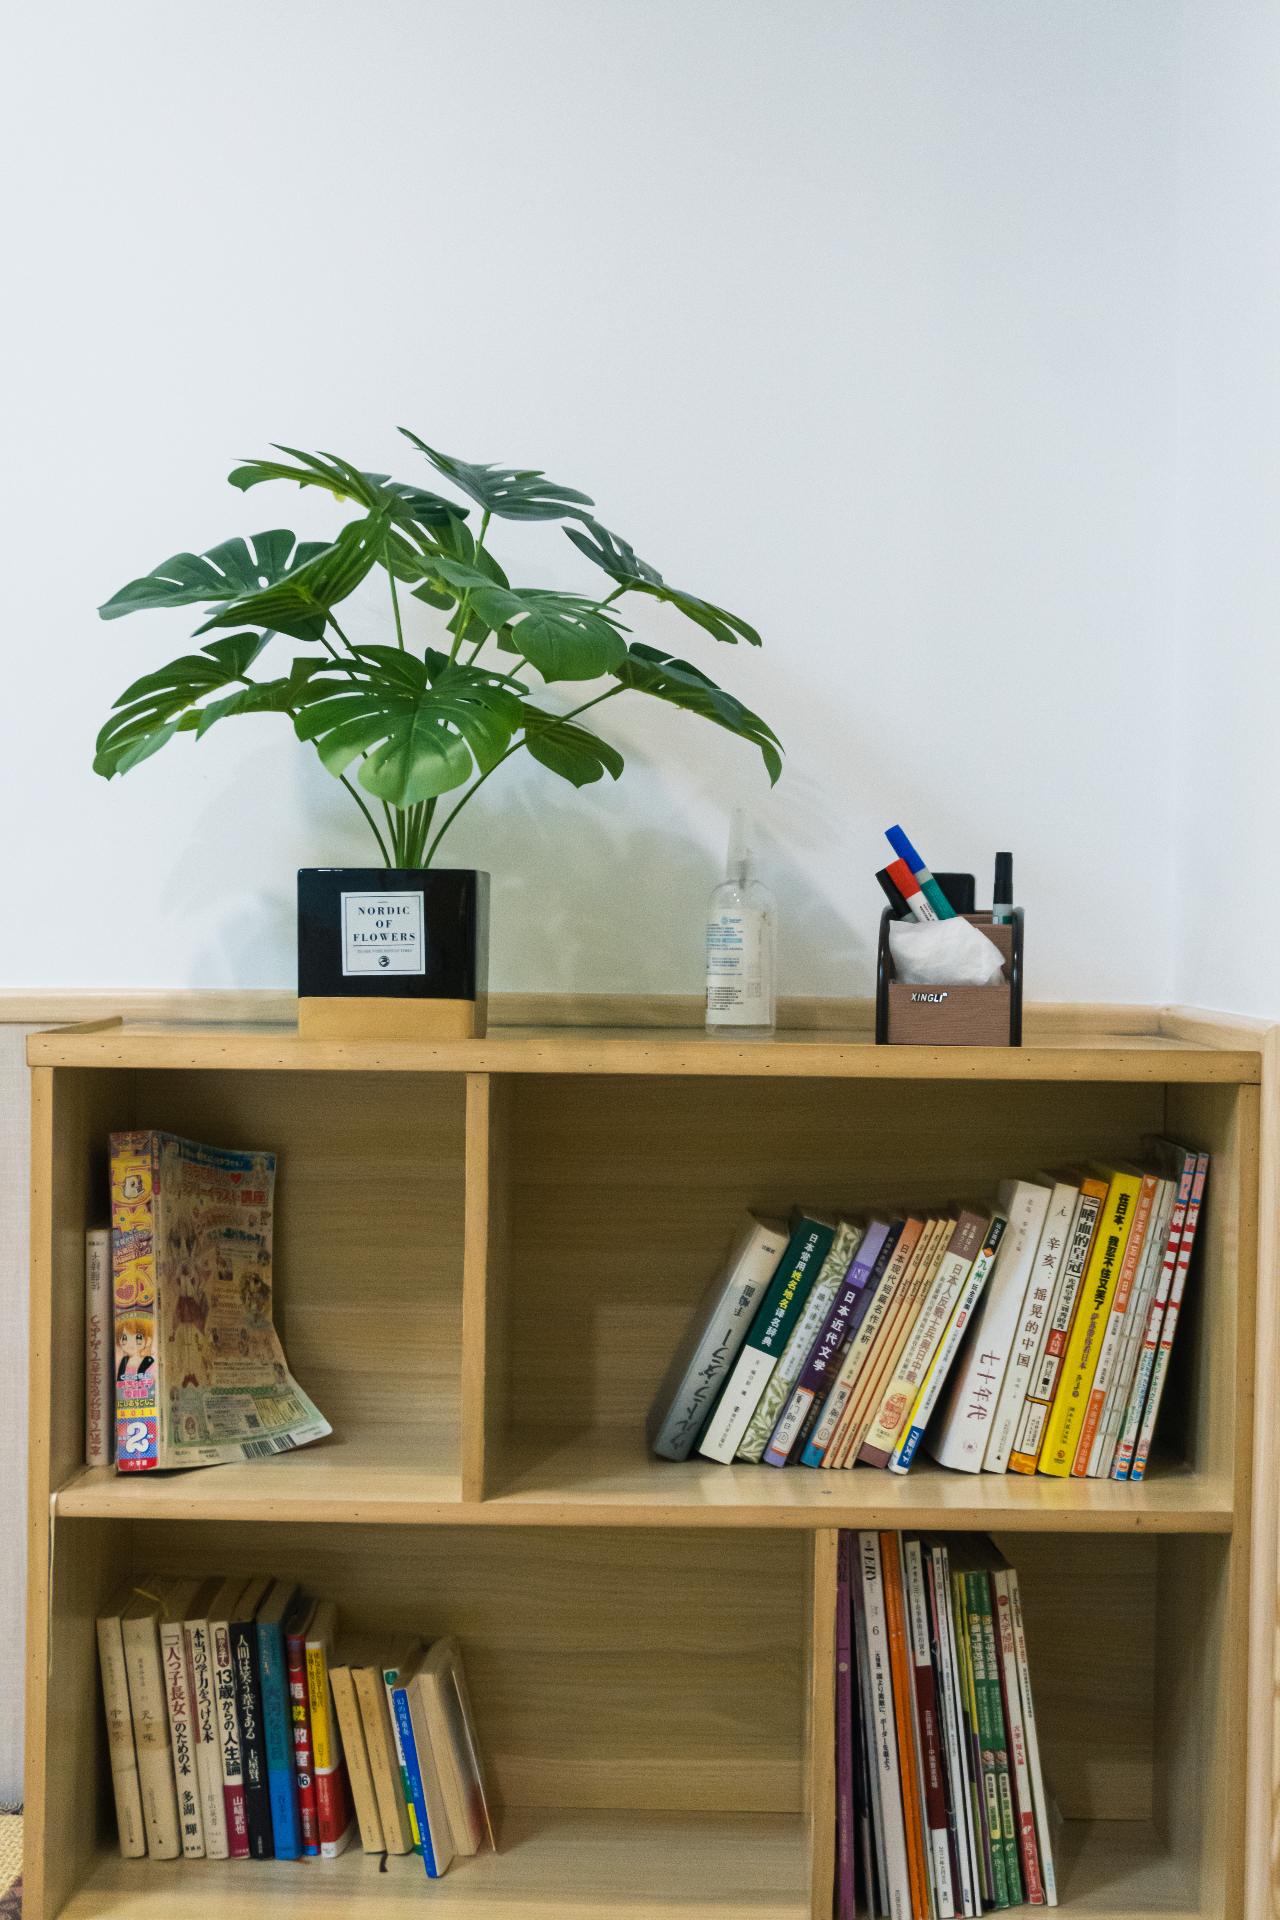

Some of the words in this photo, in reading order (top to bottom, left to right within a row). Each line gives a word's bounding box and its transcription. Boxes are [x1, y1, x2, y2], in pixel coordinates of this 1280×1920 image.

[358, 906, 410, 915] NORDIC
[376, 919, 393, 928] OF
[353, 932, 416, 942] FLOWERS
[911, 992, 946, 1003] XINGLI
[812, 1291, 856, 1372] 日本近代文学
[968, 1350, 1000, 1421] 七十年代
[126, 1421, 149, 1453] 2
[872, 1625, 879, 1636] 6
[193, 1627, 214, 1744] 本当の学力をつける本
[183, 1790, 196, 1816] 多湖
